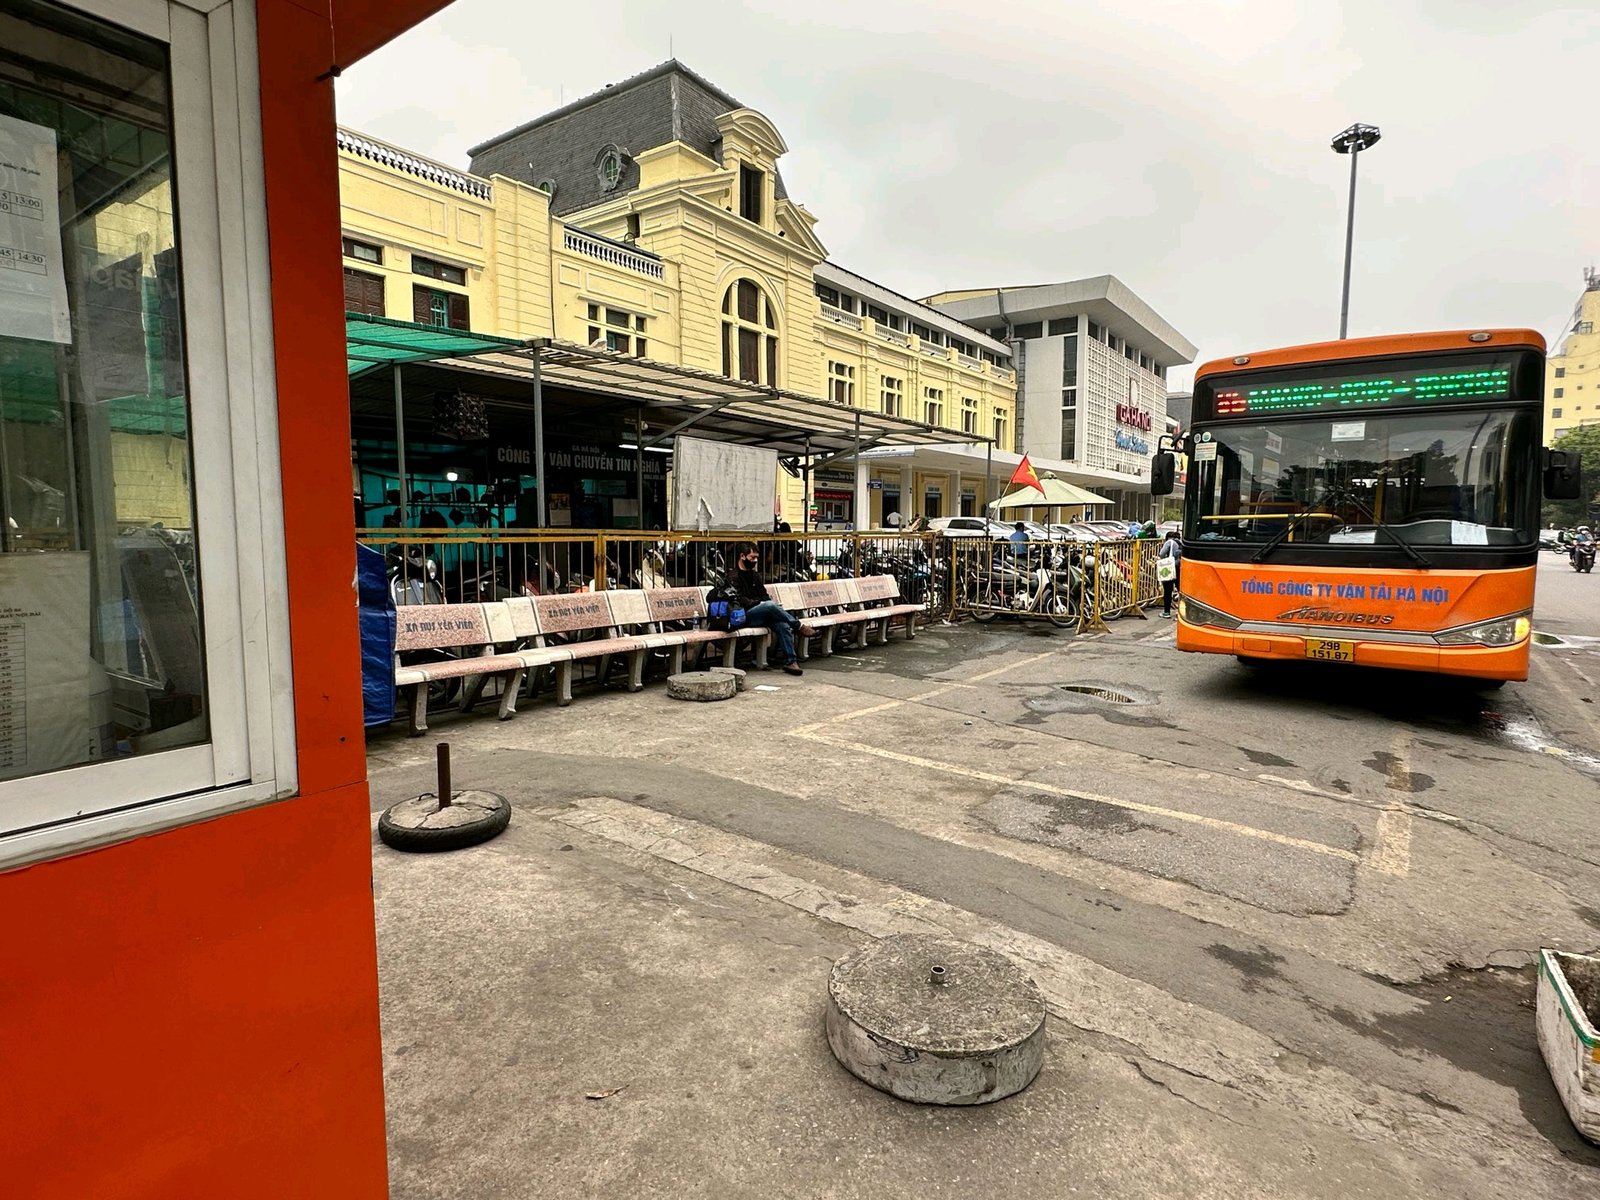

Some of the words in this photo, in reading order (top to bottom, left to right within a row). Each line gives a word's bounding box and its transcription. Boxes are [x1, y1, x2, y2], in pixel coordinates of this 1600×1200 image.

[14, 195, 40, 208] 13:00
[18, 252, 43, 264] 14:30
[497, 445, 531, 465] CÔNG
[550, 453, 572, 470] VẬN
[574, 452, 612, 471] CHUYỂN
[615, 453, 632, 472] TÍN
[1241, 576, 1274, 595] TỔNG
[1277, 581, 1313, 597] CÔNG
[1316, 584, 1333, 597] TY
[1336, 582, 1365, 600] VẬN
[1369, 582, 1392, 600] TẢI
[1396, 585, 1417, 603] HÀ
[1421, 587, 1450, 607] NỘI
[1319, 641, 1341, 651] 29B
[1311, 649, 1349, 662] 151.87
